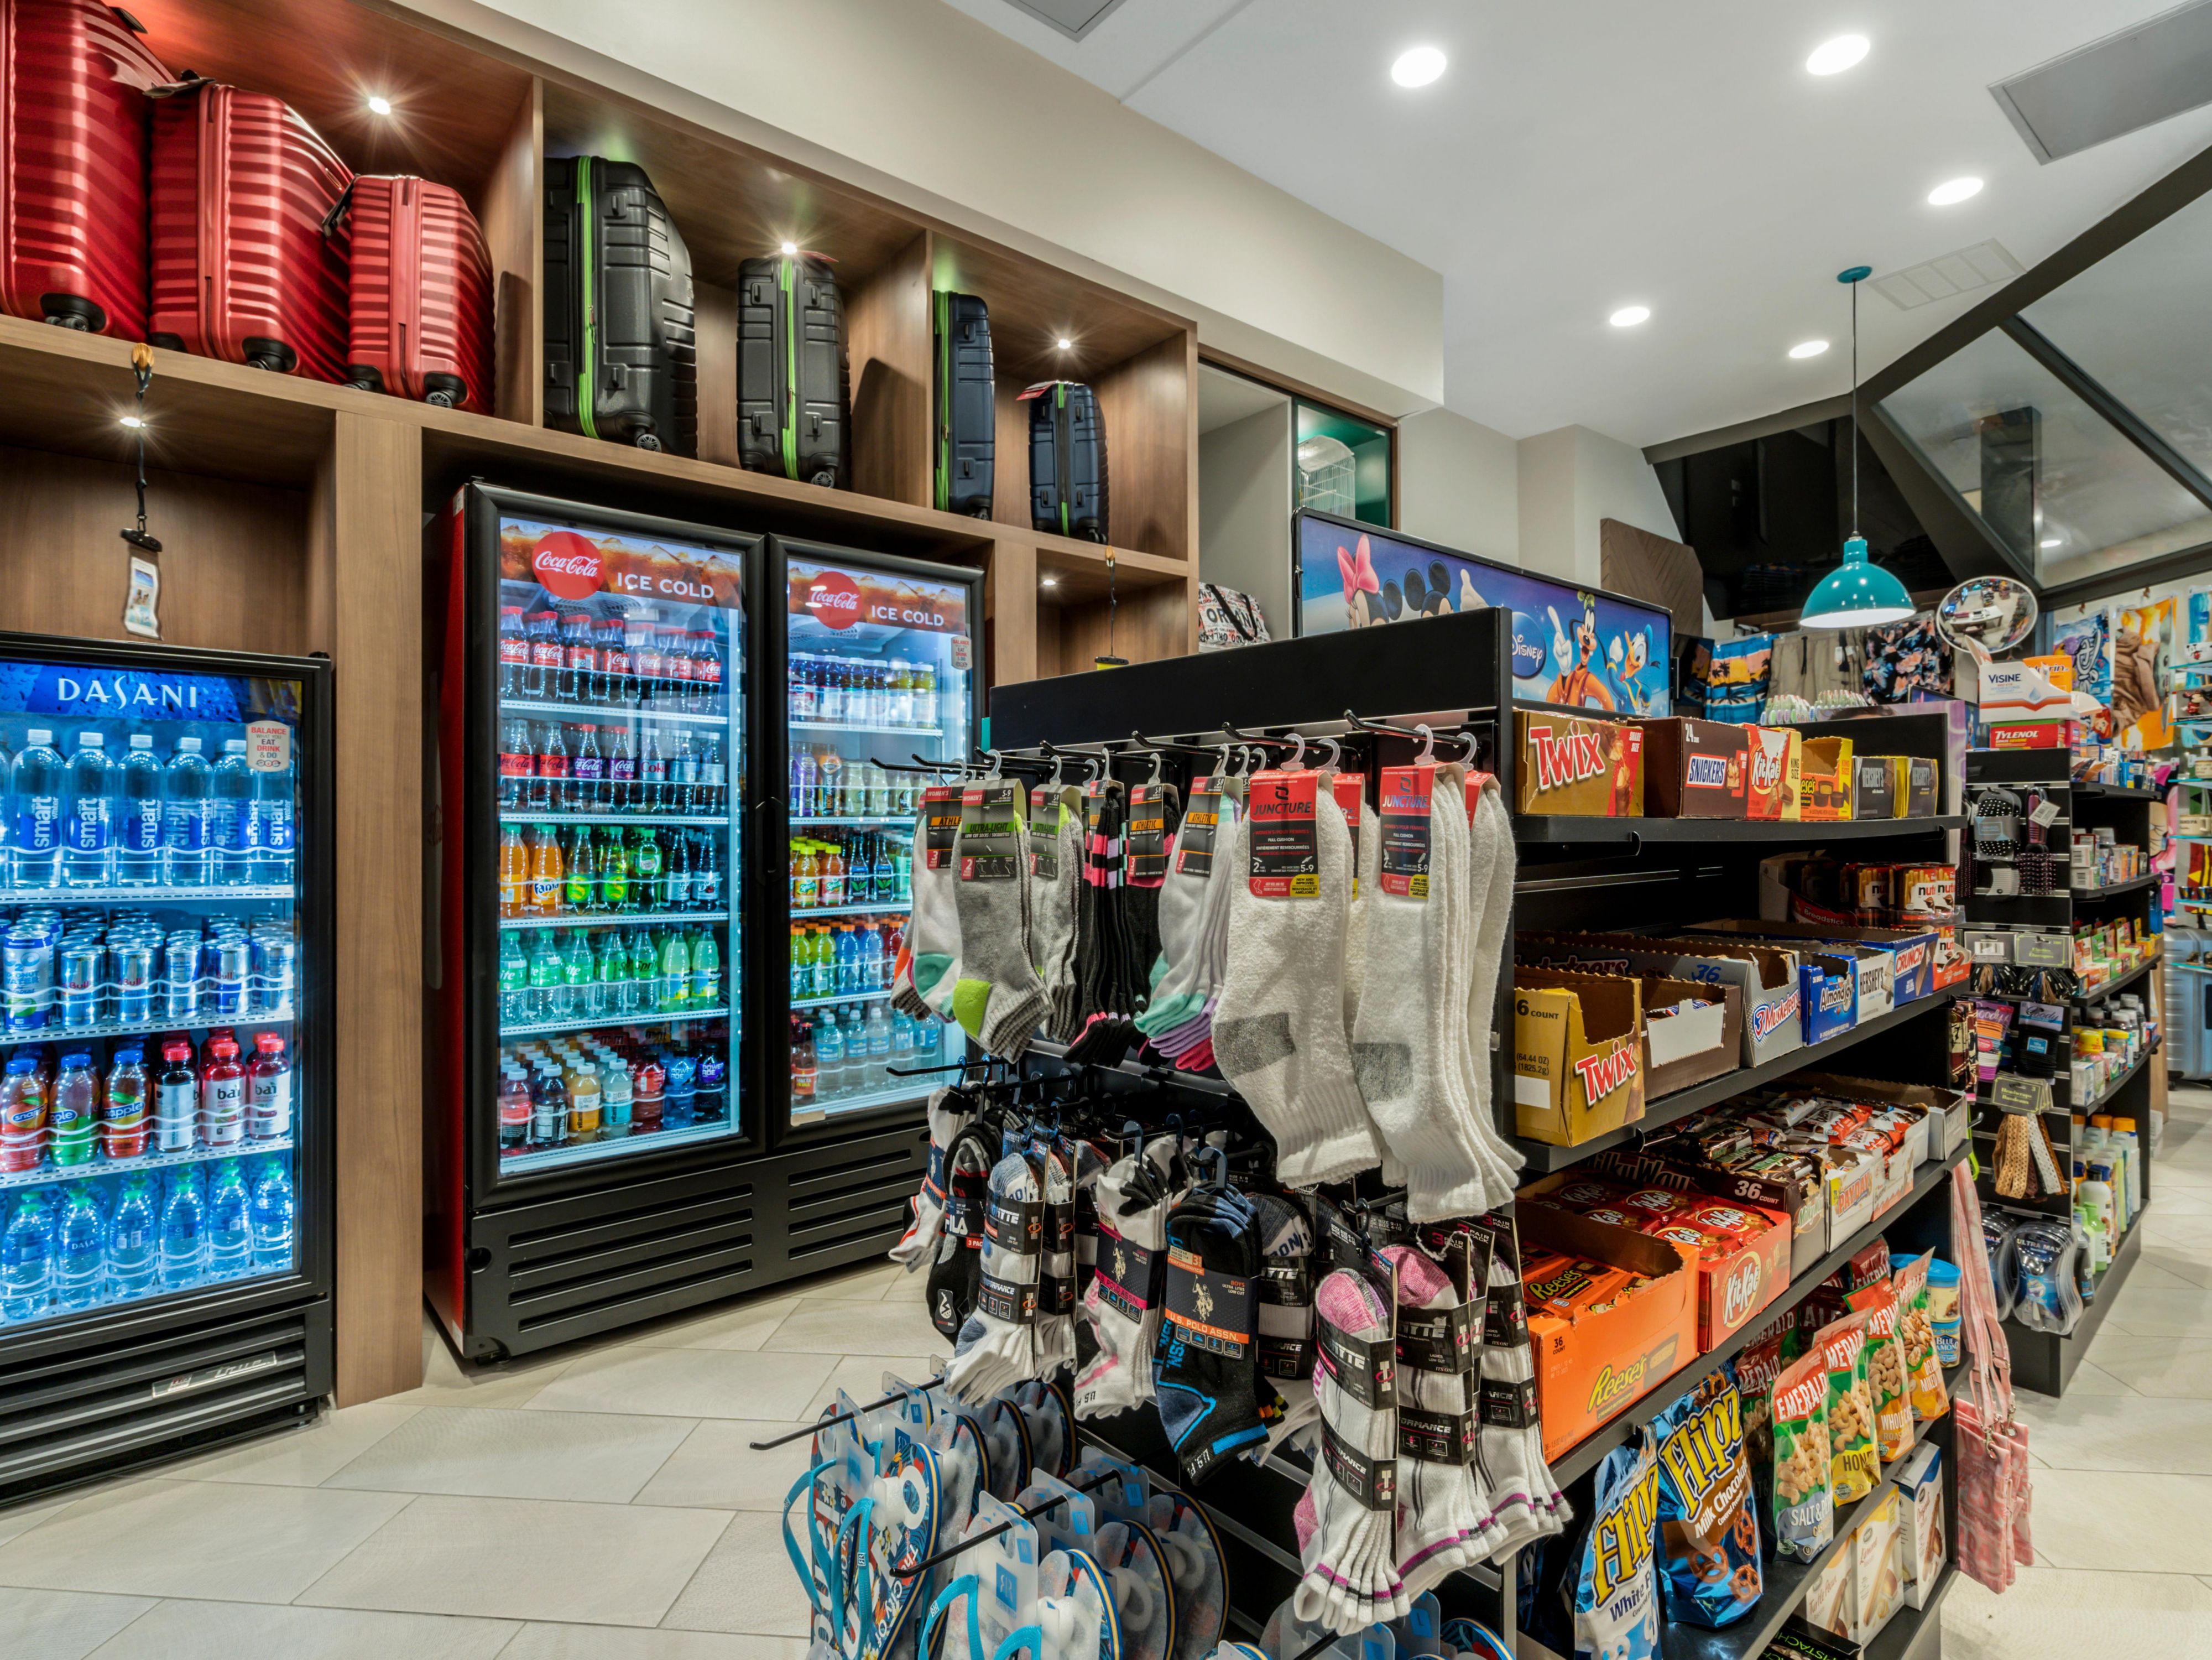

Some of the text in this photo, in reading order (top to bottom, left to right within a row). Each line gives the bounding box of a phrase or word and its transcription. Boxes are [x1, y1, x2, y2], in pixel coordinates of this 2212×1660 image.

[535, 551, 601, 577] Coca-Cola
[618, 573, 714, 599] ICE COLD
[872, 605, 944, 627] ICE COLD
[1989, 674, 2021, 684] VISINE
[58, 675, 197, 709] DASANI
[1629, 731, 1641, 741] SHARE
[1686, 724, 1694, 742] 24
[1995, 731, 2039, 740] TYLENOL
[1528, 721, 1605, 790] Twix
[1631, 743, 1640, 752] SIZE
[1688, 758, 1726, 784] SNICKERS
[1791, 758, 1799, 769] KING
[1791, 769, 1799, 779] SIZE
[1862, 767, 1884, 788] HERSHEY'S
[1253, 802, 1312, 815] JUNCTURE
[1383, 795, 1429, 808] JUNCTURE
[32, 796, 52, 847] smart
[78, 797, 107, 848] smart water
[138, 799, 157, 848] smart
[270, 799, 284, 846] smart
[970, 823, 1008, 832] ULTRA-LIGHT
[1136, 820, 1156, 829] ATHLETIC
[1192, 813, 1212, 823] ATHLETIC
[932, 851, 938, 861] 3
[966, 858, 973, 870] 2
[1131, 857, 1135, 867] 3
[1180, 852, 1185, 863] 3
[1384, 858, 1428, 872] 2 5-9
[1253, 862, 1259, 872] 2
[1804, 908, 1850, 927] Breadsticks
[1896, 946, 1924, 972] CRUNCH
[1691, 964, 1721, 983] 36
[1859, 967, 1884, 996] HERSHEY'S
[1531, 1010, 1559, 1019] COUNT
[1755, 1009, 1765, 1037] 3
[1516, 1053, 1550, 1065] (64.44 OZ)
[1519, 1064, 1550, 1076] (1825.2g)
[1576, 1040, 1636, 1107] Twix
[217, 1085, 241, 1100] bai
[255, 1082, 277, 1095] bai
[1735, 1180, 1779, 1204] 36 COUNT
[1838, 1171, 1870, 1215] PAYDAY
[945, 1214, 968, 1236] FILA
[1698, 1209, 1748, 1229] KitKat
[1432, 1232, 1464, 1245] 3 PAIR
[1457, 1222, 1490, 1240] 3 PAIR
[1469, 1234, 1489, 1244] PACK
[2016, 1239, 2061, 1253] ULTRA MAX
[1193, 1255, 1198, 1266] 3
[1372, 1253, 1391, 1272] 3 PAIR
[1528, 1268, 1584, 1300] Reese's
[1725, 1263, 1760, 1325] KitKat
[1170, 1311, 1239, 1341] U.S. POLO ASSN.
[1553, 1345, 1566, 1355] COUNT
[1554, 1336, 1563, 1348] 36
[1937, 1336, 1955, 1345] BLUE
[1587, 1355, 1647, 1414] Reese's
[1776, 1369, 1828, 1420] EMERALD
[1659, 1383, 1743, 1522] Flipz
[1695, 1506, 1717, 1539] Milk
[1718, 1505, 1733, 1526] Covered
[1791, 1501, 1822, 1527] SALT &
[1610, 1584, 1645, 1622] White
